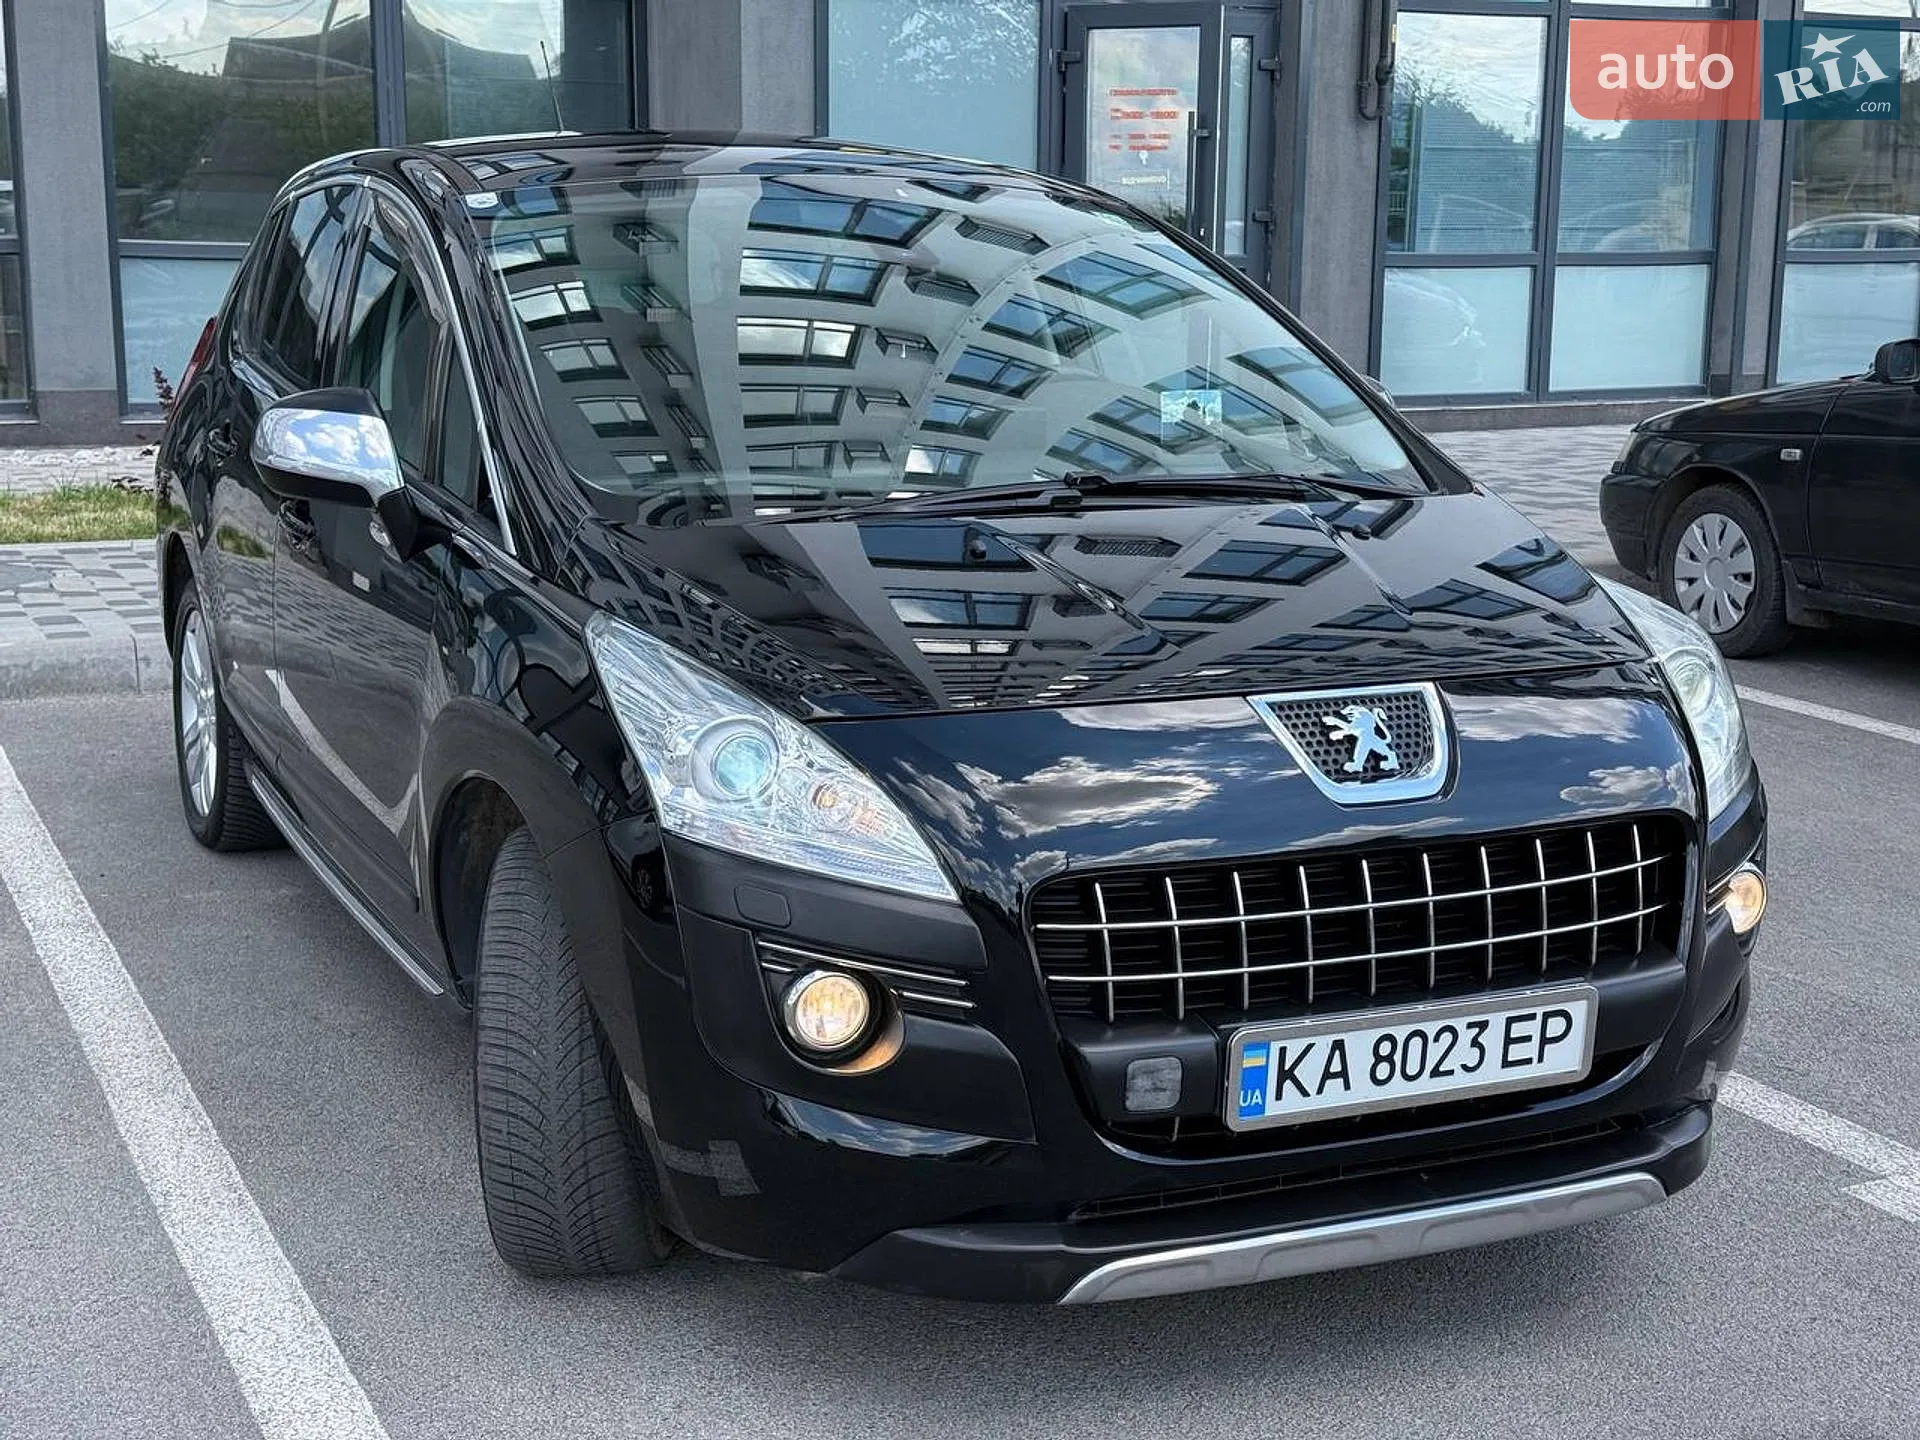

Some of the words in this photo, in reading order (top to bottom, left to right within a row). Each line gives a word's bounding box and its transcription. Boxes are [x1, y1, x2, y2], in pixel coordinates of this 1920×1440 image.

[1275, 1039, 1351, 1101] KA
[1369, 1019, 1490, 1087] 8023
[1501, 1009, 1573, 1069] EP
[1239, 1089, 1263, 1107] UA
